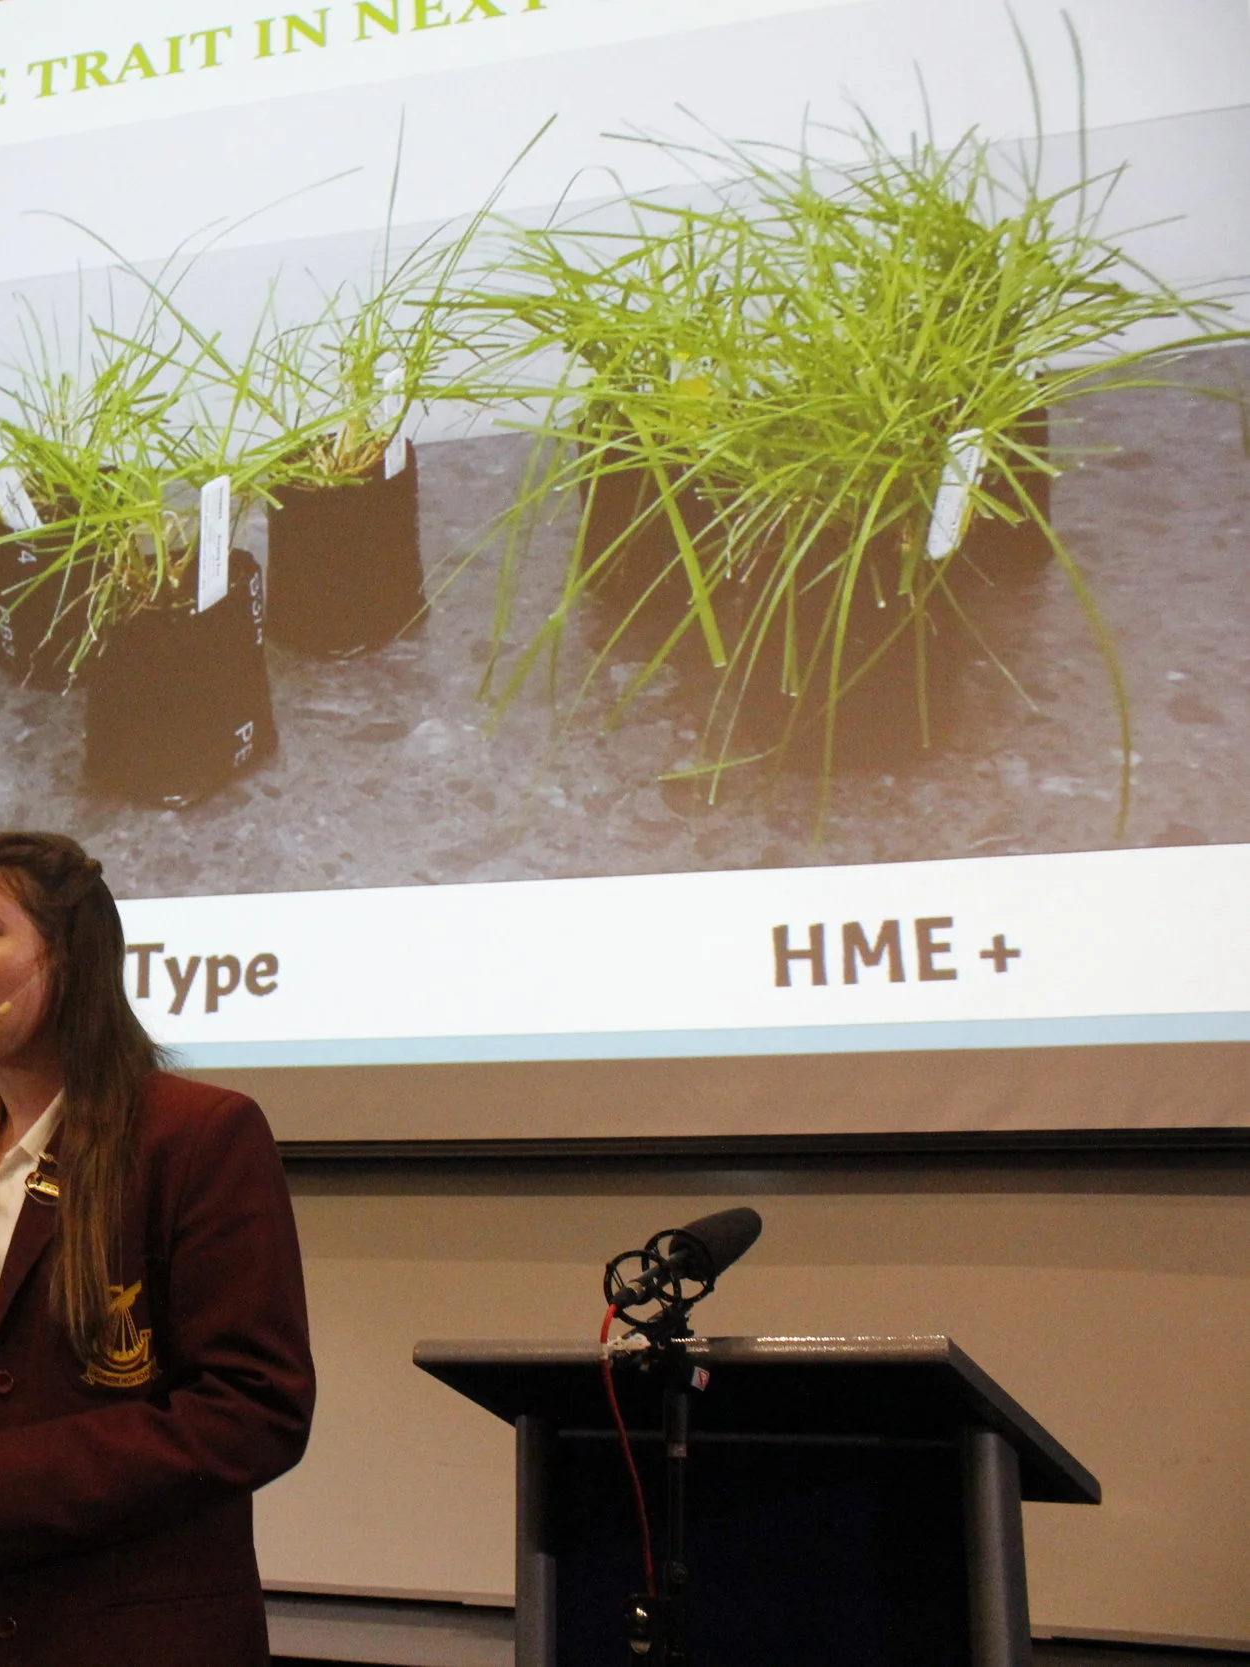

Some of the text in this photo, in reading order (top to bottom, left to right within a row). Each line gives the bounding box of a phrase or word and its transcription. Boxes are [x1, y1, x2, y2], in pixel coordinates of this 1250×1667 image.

[27, 26, 232, 99] TRAIT
[253, 8, 330, 59] IN
[125, 943, 279, 1016] Type
[772, 916, 958, 988] HME
